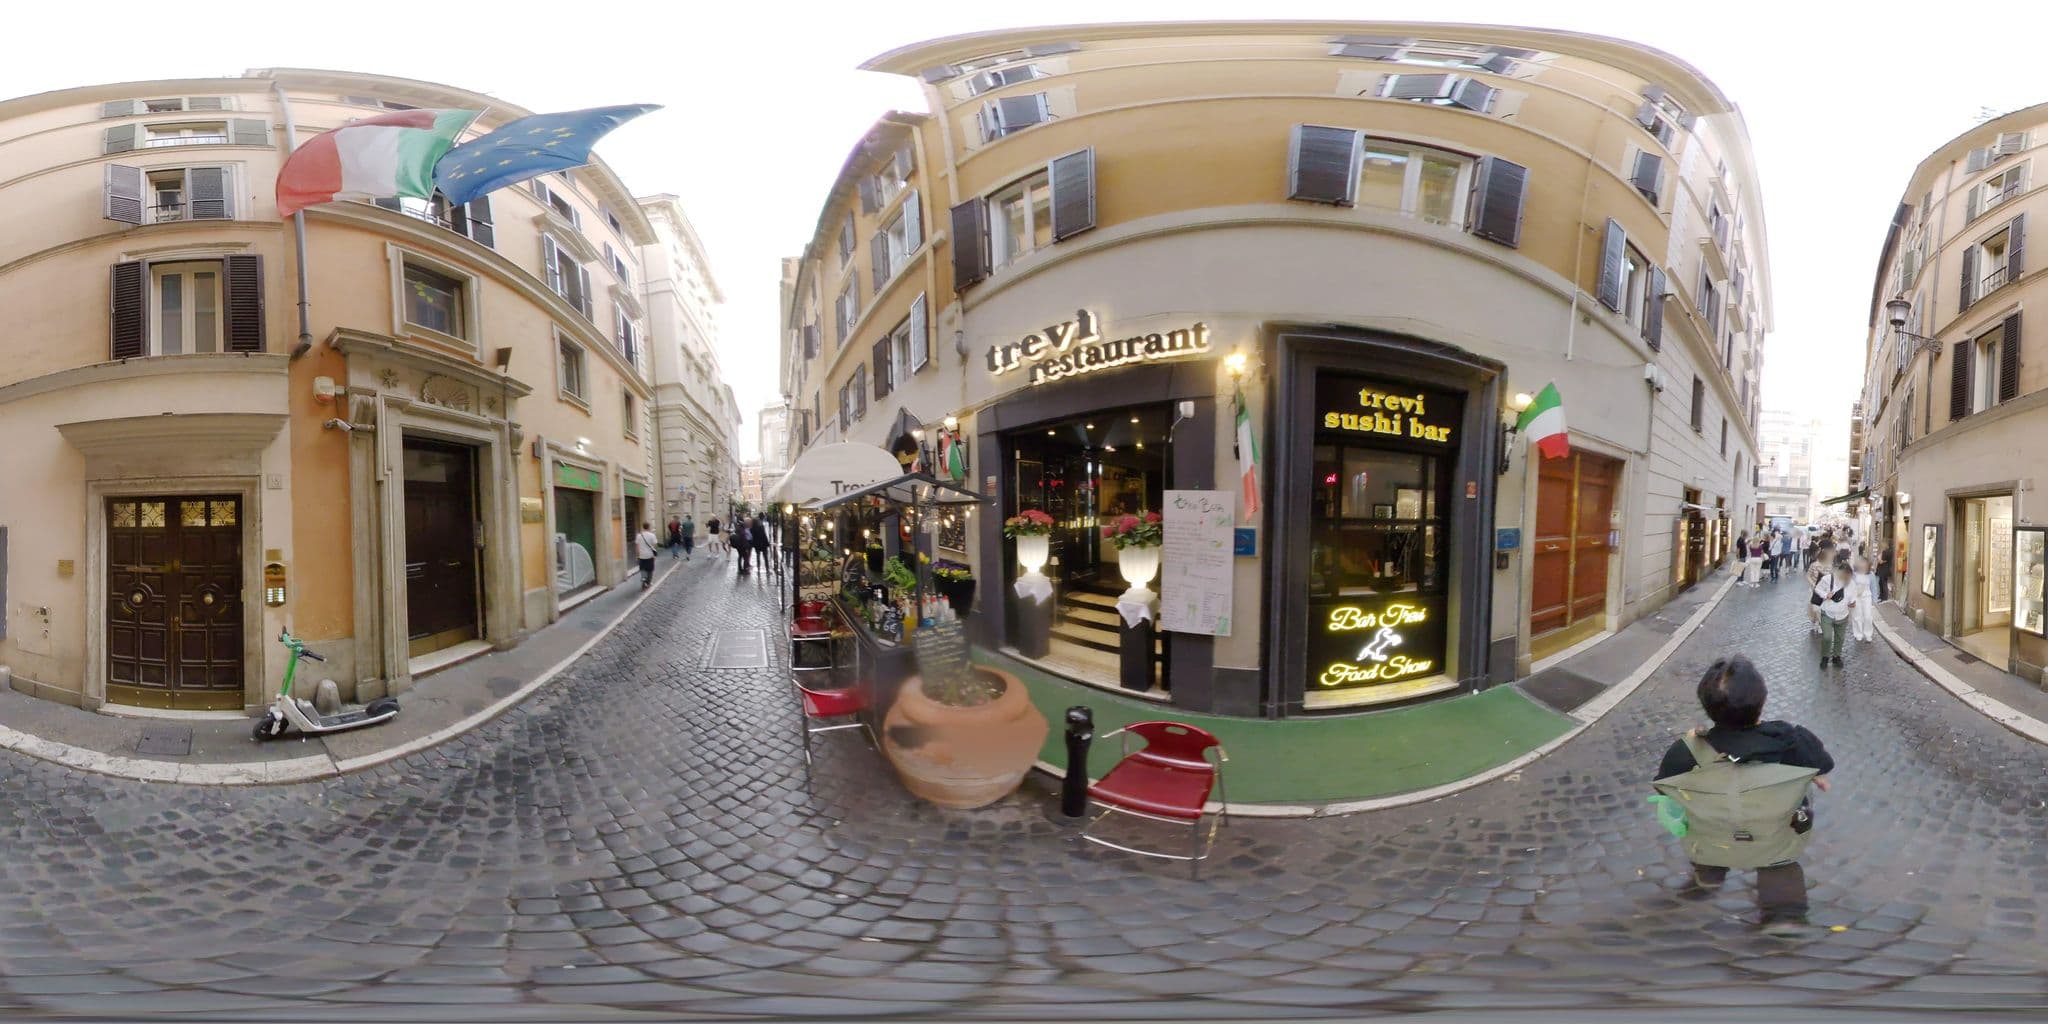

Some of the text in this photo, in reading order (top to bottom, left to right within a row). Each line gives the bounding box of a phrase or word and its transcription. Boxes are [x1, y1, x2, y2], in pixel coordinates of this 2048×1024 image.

[985, 308, 1099, 376] trevi
[1028, 321, 1210, 385] restaurant
[1358, 388, 1426, 416] trevi
[1324, 411, 1451, 442] sushi bar
[1328, 606, 1377, 631] Bar
[1320, 655, 1433, 686] Food Show
